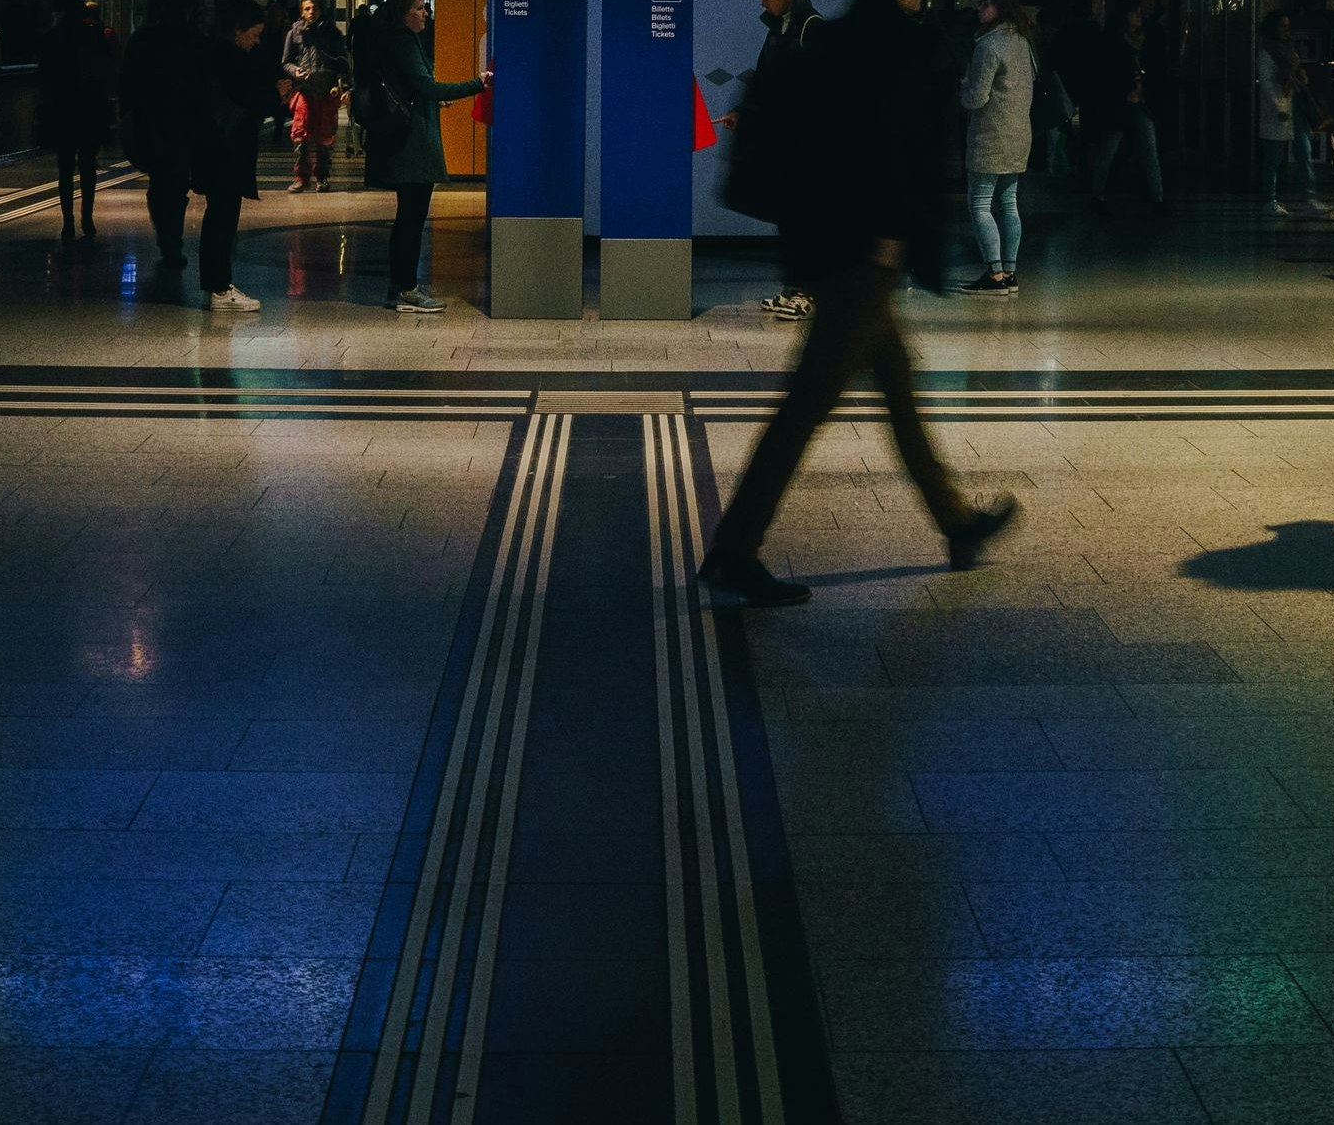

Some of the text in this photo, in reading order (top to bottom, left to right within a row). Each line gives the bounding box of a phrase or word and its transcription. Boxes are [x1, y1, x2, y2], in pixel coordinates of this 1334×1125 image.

[504, 0, 529, 9] Biglietti
[504, 8, 528, 16] Tickets
[652, 22, 676, 30] Biglietti
[651, 30, 676, 38] Tickets
